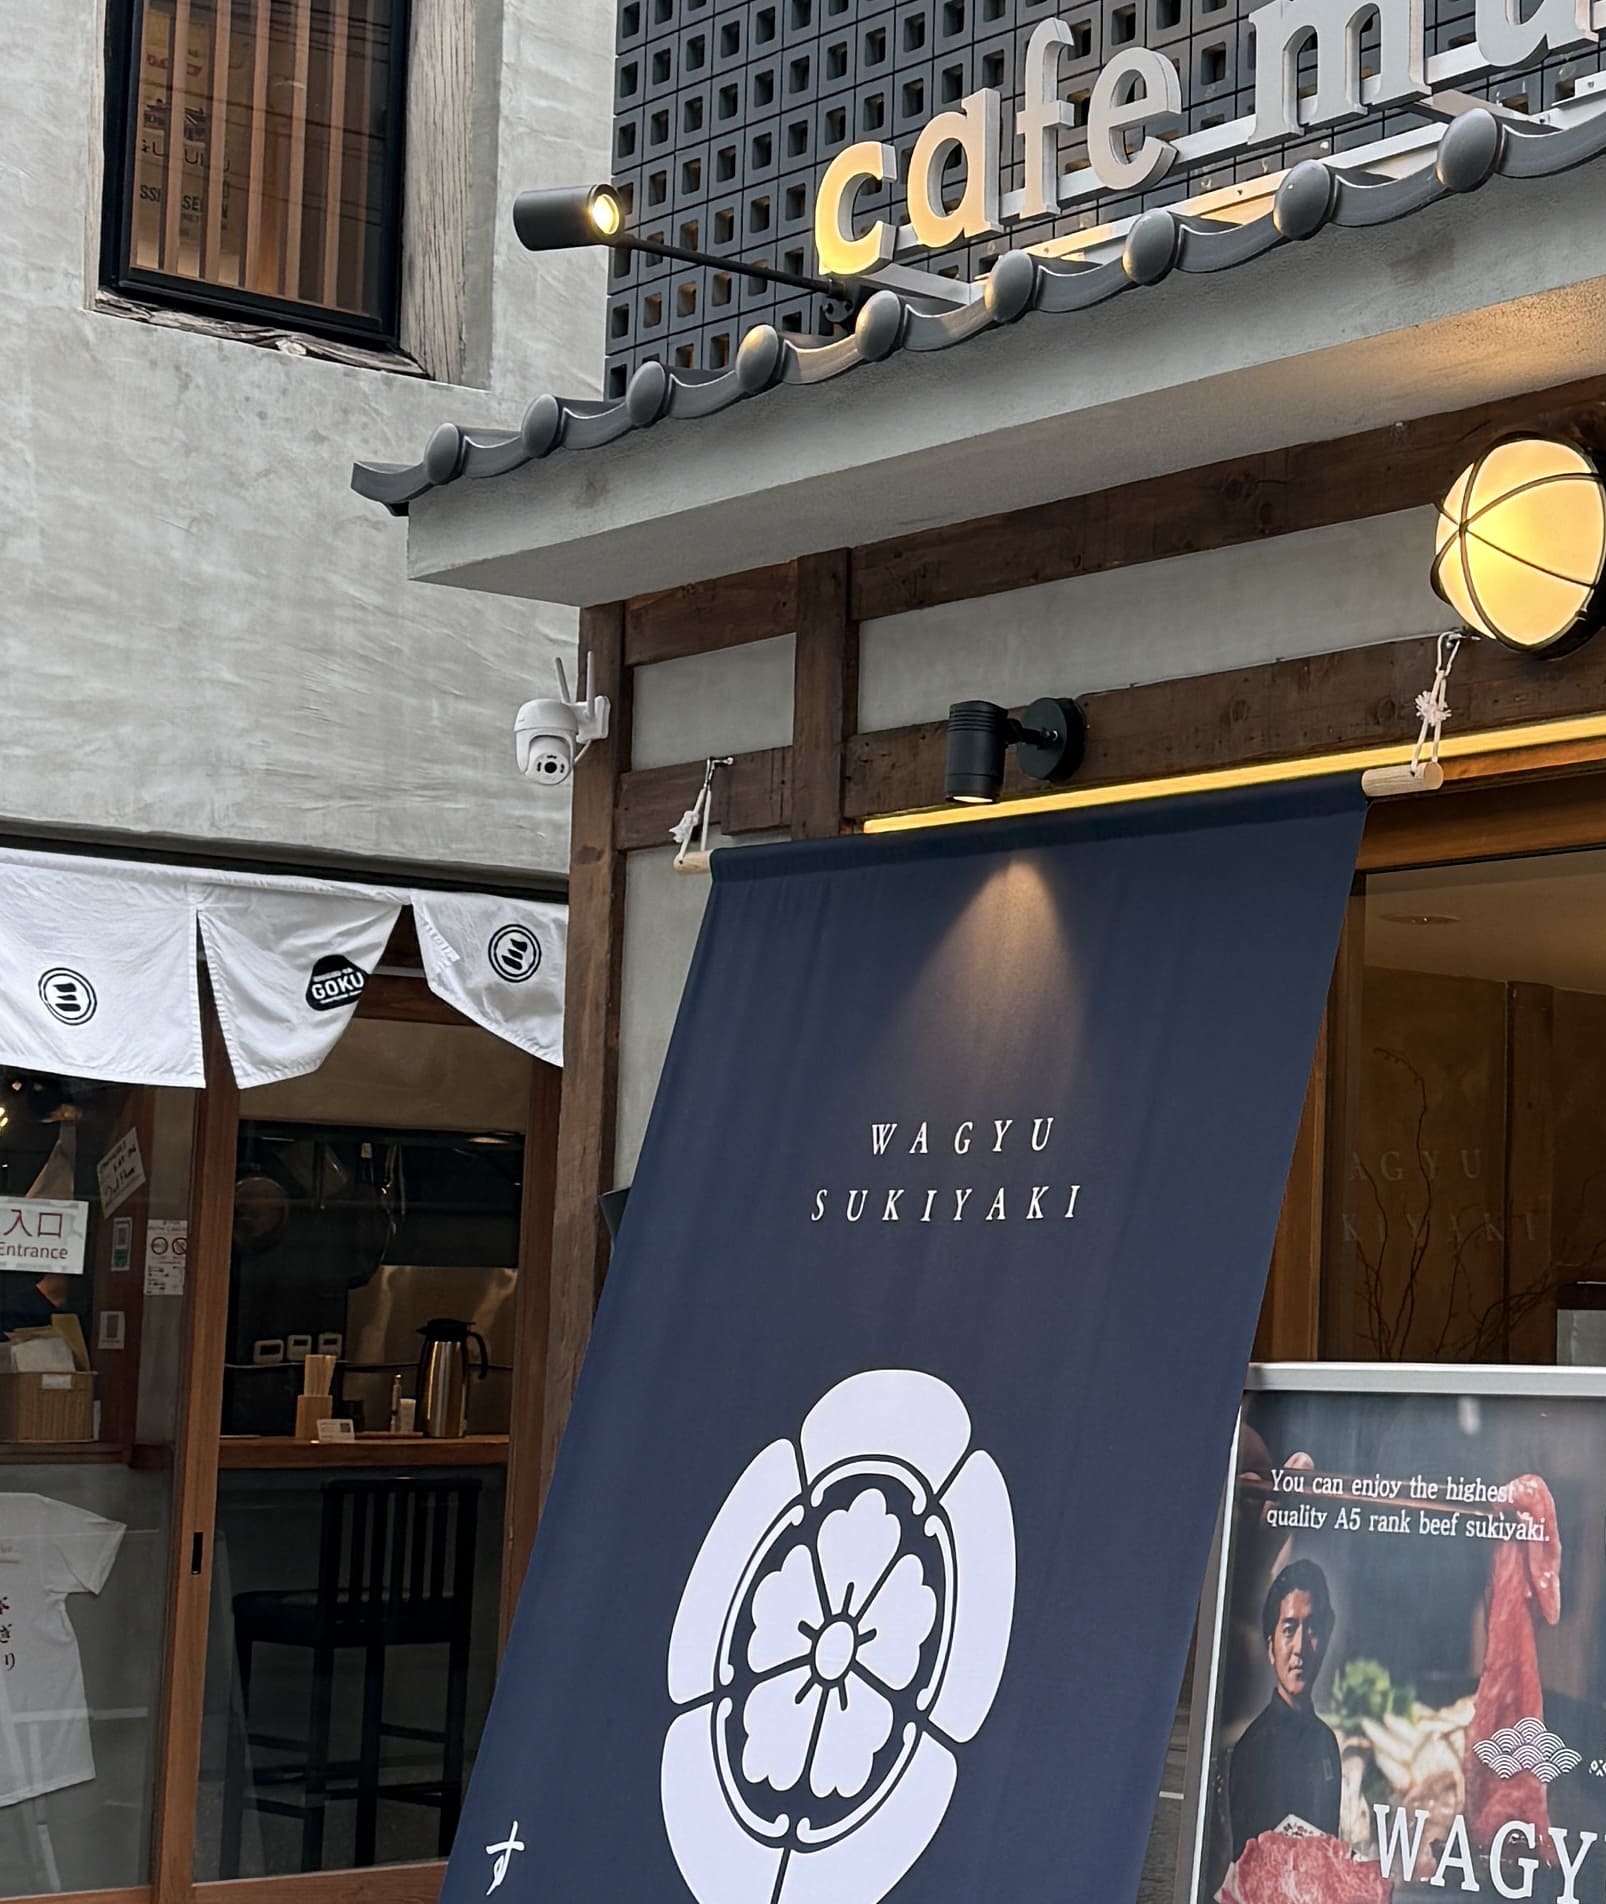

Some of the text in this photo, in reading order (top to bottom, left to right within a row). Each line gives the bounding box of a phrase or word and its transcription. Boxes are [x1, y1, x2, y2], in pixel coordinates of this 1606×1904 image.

[816, 17, 1183, 277] cafe
[312, 972, 364, 999] GOKU
[871, 1117, 1054, 1155] WAGYU
[811, 1185, 1080, 1221] SUKIYAKI
[3, 1208, 64, 1239] 入口
[1271, 1469, 1515, 1504] You can enjoy the highest
[1266, 1505, 1550, 1542] quality A5 rank beef sukiyaki.
